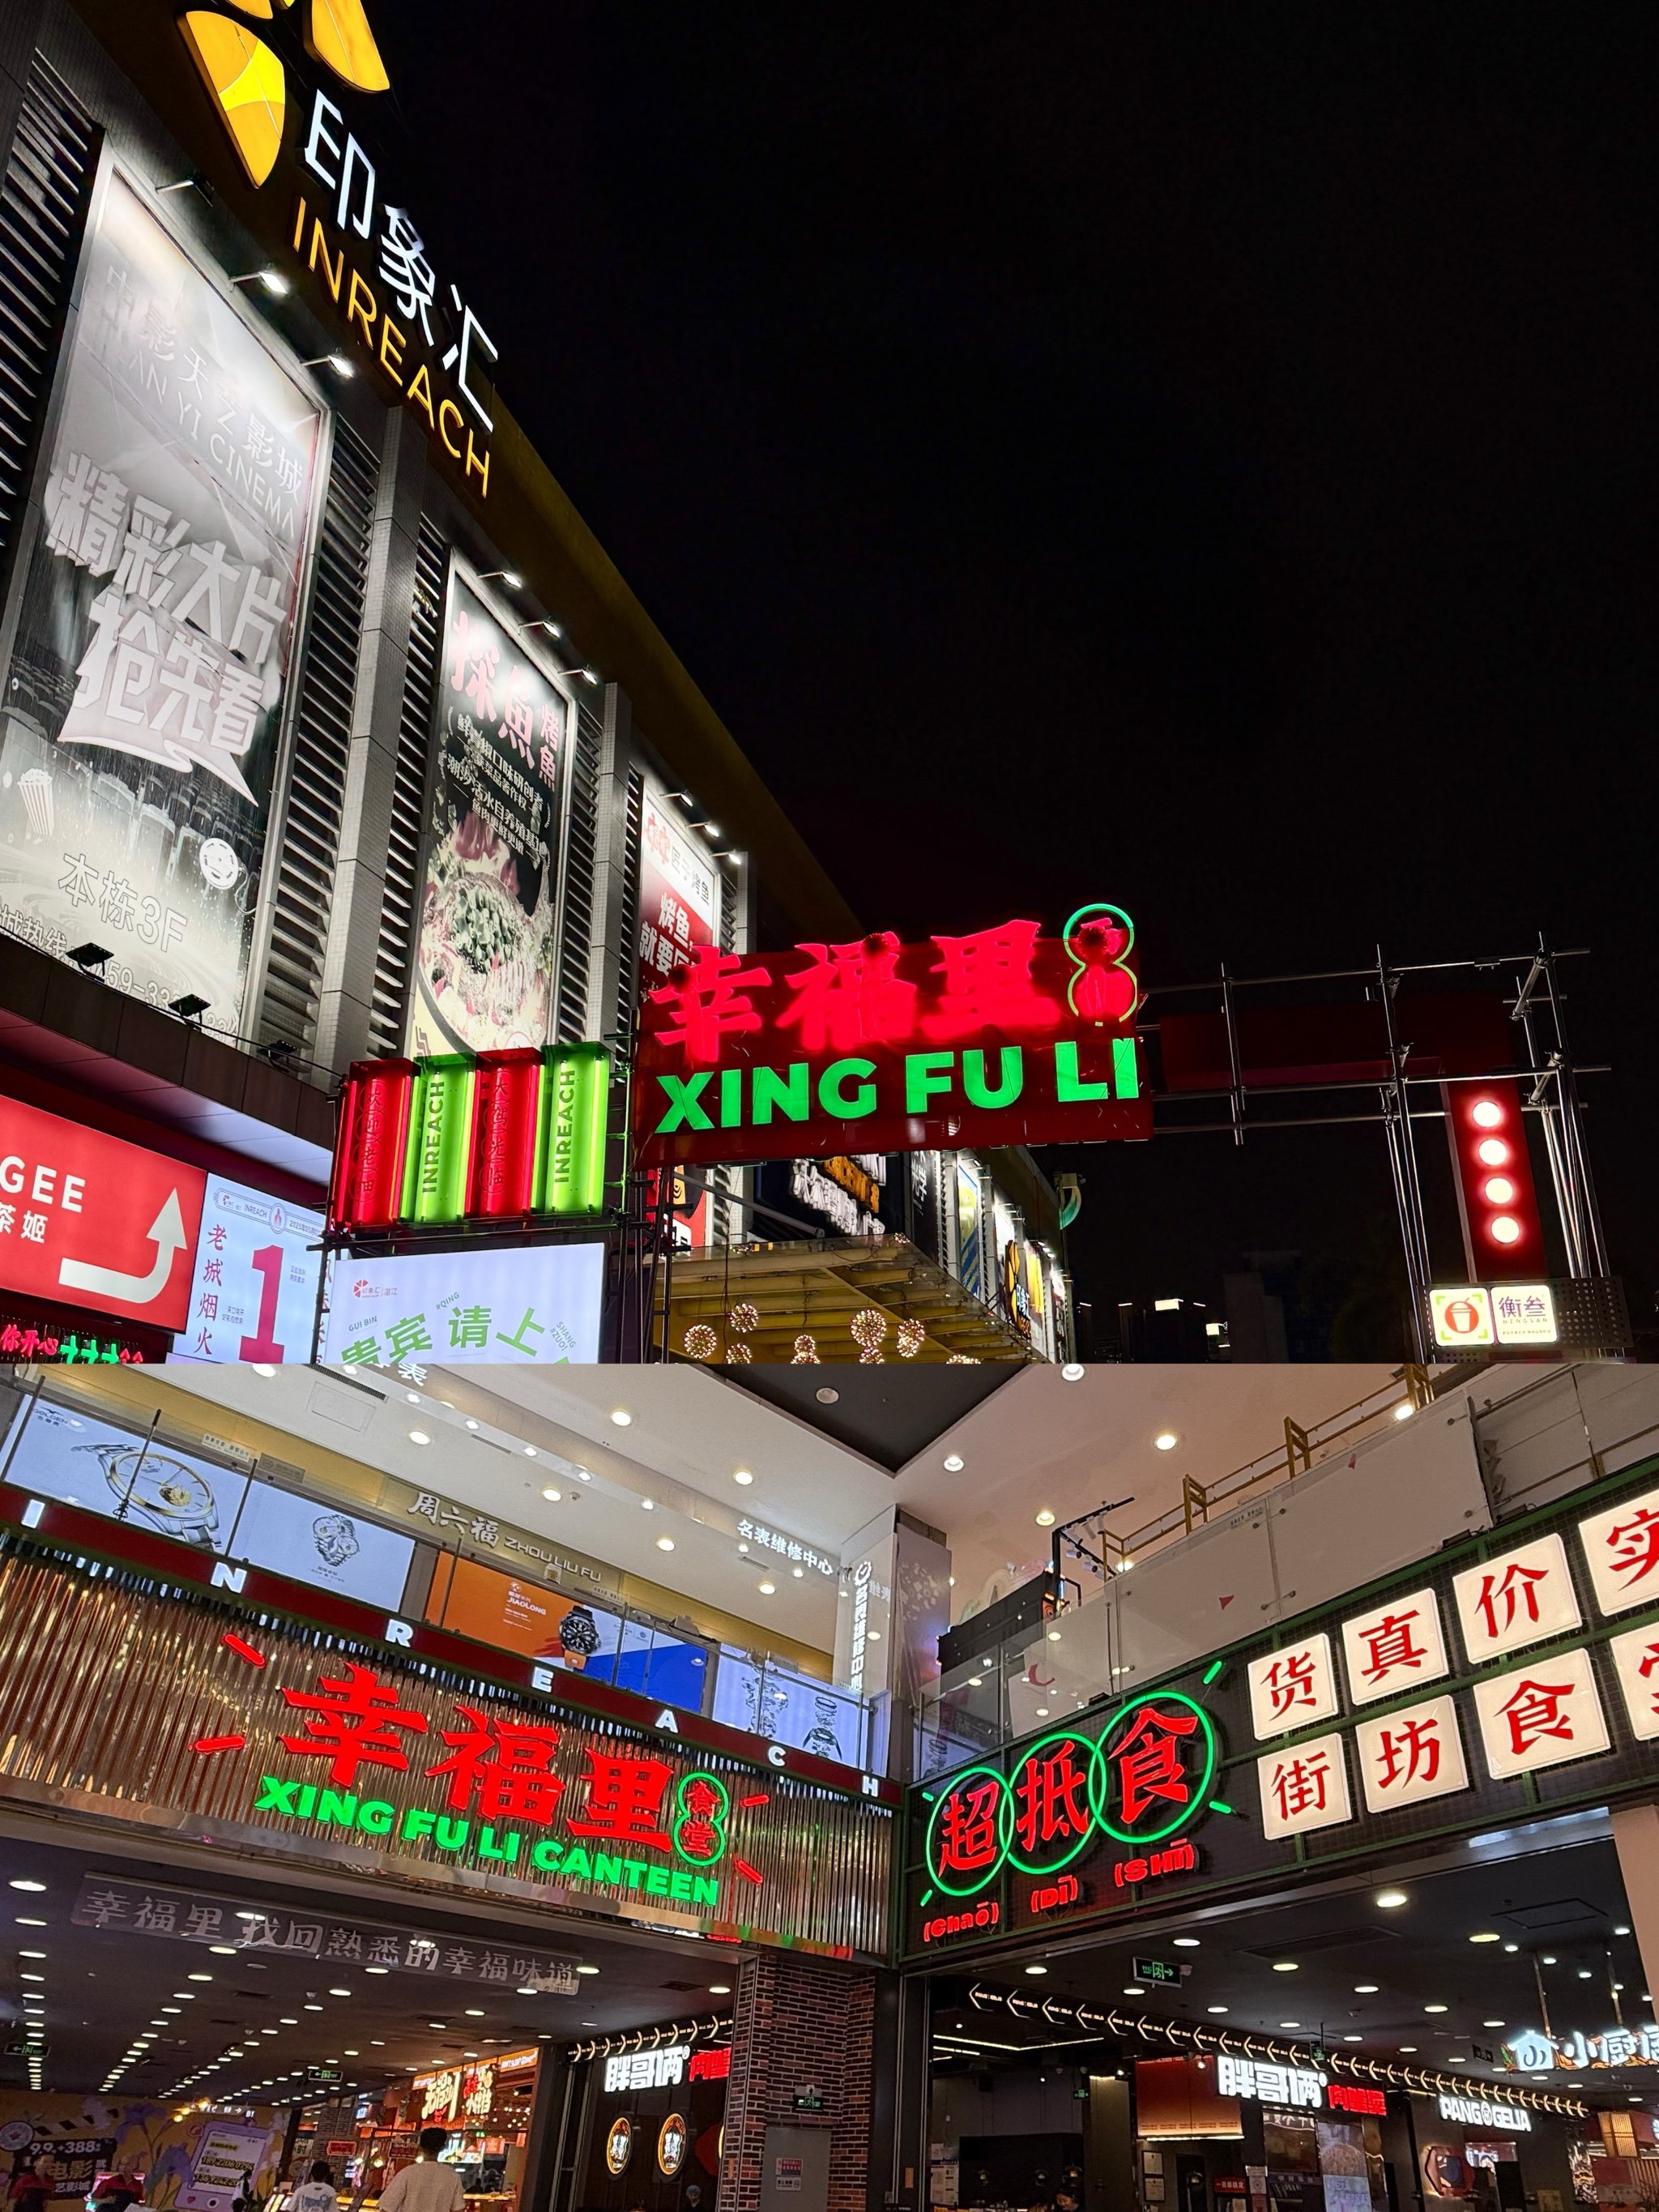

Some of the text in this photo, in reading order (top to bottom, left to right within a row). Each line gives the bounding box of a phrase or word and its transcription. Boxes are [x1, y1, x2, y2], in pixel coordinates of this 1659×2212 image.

[305, 88, 498, 433] 印象汇
[292, 196, 491, 498] INREACH
[46, 451, 288, 664] 精彩大片
[75, 588, 266, 756] 抢先看
[58, 852, 187, 953] 本栋3F
[648, 919, 1060, 1063] 幸福里
[422, 1082, 445, 1194] INREACH
[554, 1070, 575, 1183] INREACH
[655, 1038, 1140, 1134] XING FU LI
[1, 1155, 87, 1214] GEE
[194, 1223, 228, 1356] 老城烟火
[239, 1245, 284, 1364] 1
[348, 1315, 378, 1333] GUI BIN
[557, 1322, 576, 1348] SHANG
[407, 1491, 500, 1548] 周六福
[504, 1535, 602, 1582] ZHOU LIU FU
[737, 1518, 834, 1576] 名表维修中心
[507, 1595, 547, 1616] JIAOLONG
[279, 1661, 675, 1854] 幸福里
[1271, 1644, 1659, 1821] 街坊食
[254, 1776, 719, 1907] XING FU LI CANTEEN
[681, 1779, 723, 1857] 食堂
[937, 1706, 1199, 1880] 超抵食
[604, 2046, 684, 2093] 胖哥俩
[1218, 2055, 1324, 2108] 胖哥俩
[1439, 2096, 1532, 2133] PANG GELIA
